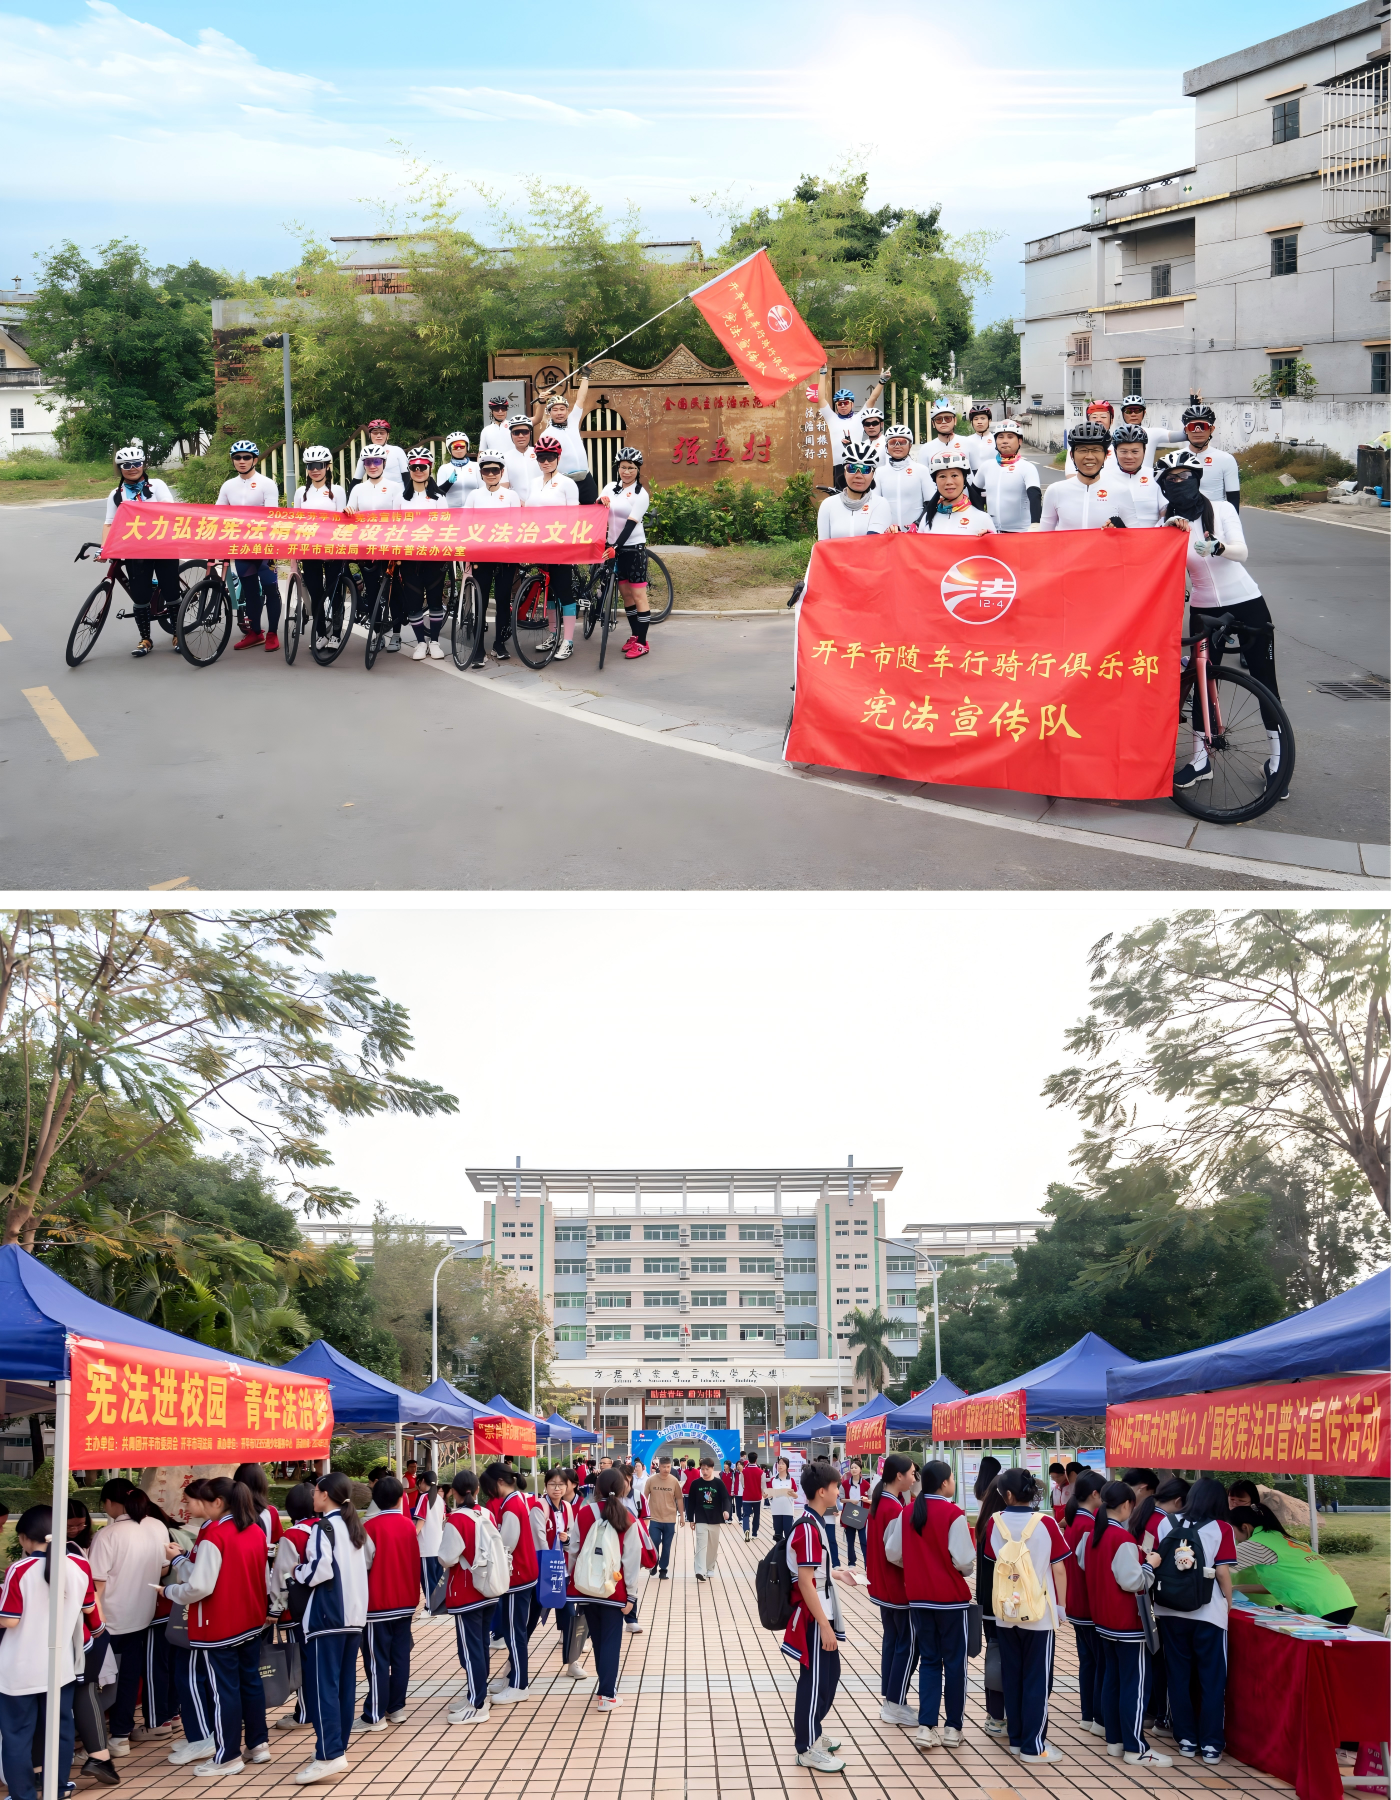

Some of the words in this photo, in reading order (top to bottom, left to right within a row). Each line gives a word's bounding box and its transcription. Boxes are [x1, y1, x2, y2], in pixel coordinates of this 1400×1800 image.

[722, 312, 767, 376] 宪法宣传队
[122, 515, 320, 541] 大力弘扬宪法精神
[330, 520, 594, 544] 建设社会主义法治文化
[366, 544, 467, 557] 开平市普法办公室
[811, 638, 1160, 684] 开平市随车行骑行俱乐部
[860, 688, 1082, 742] 宪法宣传队
[86, 1358, 227, 1428] 宪法进校园
[244, 1380, 329, 1432] 青年法治梦
